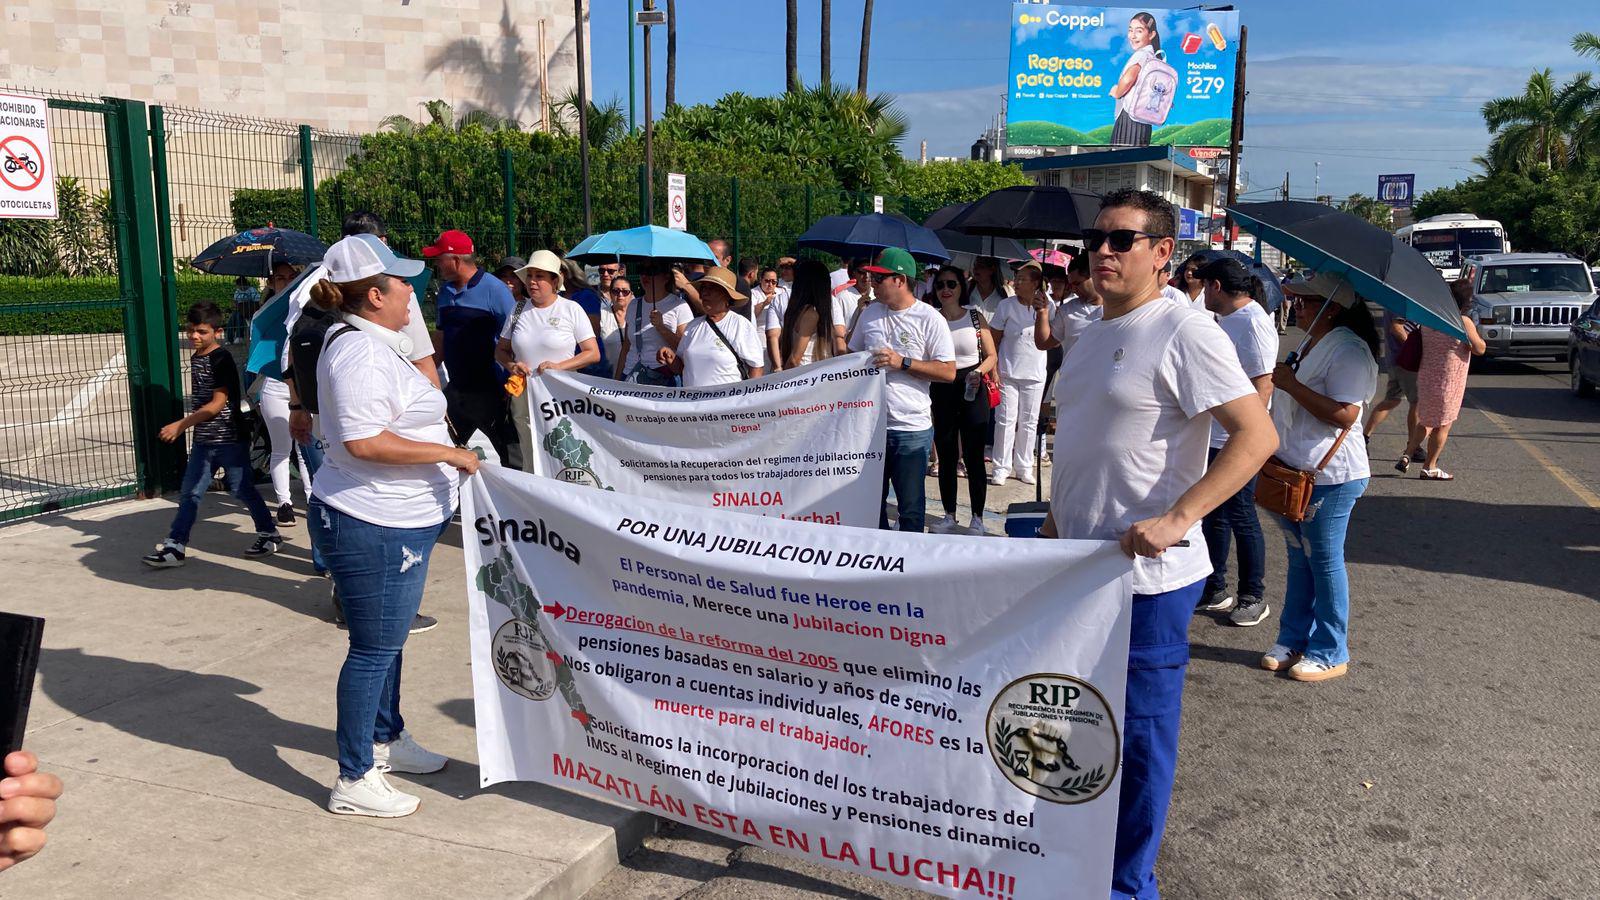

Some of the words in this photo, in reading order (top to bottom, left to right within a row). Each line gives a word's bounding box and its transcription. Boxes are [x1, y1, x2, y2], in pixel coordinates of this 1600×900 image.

[1046, 11, 1103, 30] Coppel
[1029, 54, 1093, 72] Regreso
[1017, 73, 1054, 89] para
[1059, 72, 1101, 87] todos
[1187, 77, 1224, 93] $279
[0, 201, 51, 209] OTOCICLETAS
[589, 387, 663, 399] Recuperemos
[666, 389, 676, 399] el
[679, 390, 726, 400] Regimen
[729, 387, 741, 397] de
[744, 379, 808, 395] Jubilaciones
[811, 376, 818, 386] y
[821, 368, 880, 382] Pensiones
[540, 396, 616, 423] Sinaloa
[636, 414, 665, 424] trabajo
[668, 414, 678, 422] de
[681, 414, 697, 422] una
[699, 411, 718, 422] vida
[722, 411, 756, 422] merece
[759, 410, 776, 419] una
[778, 404, 827, 418] Jubilación
[830, 403, 835, 412] y
[837, 400, 874, 409] Pension
[731, 423, 761, 433] Digna!
[620, 459, 668, 469] Solicitamos
[671, 459, 678, 468] la
[681, 458, 743, 471] Recuperacion
[747, 457, 761, 466] del
[763, 454, 801, 466] regimen
[803, 453, 813, 463] de
[815, 452, 875, 464] jubilaciones
[877, 452, 883, 461] y
[565, 471, 584, 479] RJP
[643, 472, 687, 483] pensiones
[689, 472, 709, 482] para
[712, 471, 739, 481] todos
[741, 470, 755, 479] los
[757, 467, 813, 480] trabajadores
[815, 467, 830, 476] del
[833, 466, 860, 476] IMSS.
[712, 491, 783, 507] SINALOA
[616, 517, 660, 541] POR
[662, 527, 707, 549] UNA
[707, 532, 832, 567] JUBILACION
[835, 551, 905, 573] DIGNA
[619, 557, 633, 571] El
[636, 561, 702, 588] Personal
[705, 575, 725, 592] de
[729, 580, 776, 600] Salud
[780, 586, 810, 606] fue
[815, 592, 872, 613] Heroe
[877, 602, 901, 617] en
[906, 602, 924, 619] la
[611, 578, 690, 609] pandemia,
[692, 594, 752, 619] Merece
[756, 609, 789, 626] una
[792, 612, 884, 639] Jubilacion
[889, 626, 947, 648] Digna
[514, 623, 535, 640] RJP
[564, 605, 656, 633] Derogacion
[658, 622, 677, 638] de
[680, 626, 694, 641] la
[698, 629, 763, 657] reforma
[768, 640, 793, 661] del
[798, 651, 838, 670] 2005
[843, 661, 877, 680] que
[882, 665, 952, 691] elimino
[957, 675, 982, 698] las
[578, 633, 661, 659] pensiones
[663, 644, 729, 671] basadas
[732, 662, 753, 677] en
[757, 667, 814, 689] salario
[818, 679, 829, 694] y
[833, 679, 874, 702] años
[879, 688, 900, 707] de
[905, 696, 964, 725] servio.
[564, 655, 591, 673] Nos
[594, 660, 672, 688] obligaron
[675, 677, 685, 688] a
[689, 678, 754, 702] cuentas
[758, 690, 864, 730] individuales,
[867, 714, 934, 746] AFORES
[939, 734, 960, 752] es
[966, 736, 984, 755] la
[1029, 683, 1080, 707] RJP
[1008, 703, 1055, 713] RECUPEREMOS
[1066, 708, 1094, 718] RÉGIMEN
[1013, 711, 1058, 720] JUBILACIONES
[1065, 716, 1099, 726] PENSIONES
[654, 697, 715, 720] muerte
[718, 710, 756, 730] para
[759, 716, 775, 733] el
[778, 720, 872, 758] trabajador.
[591, 716, 673, 750] Solicitamos
[677, 736, 692, 754] la
[697, 740, 809, 783] incorporacion
[813, 769, 838, 792] del
[842, 776, 867, 799] los
[871, 784, 997, 823] trabajadores
[1002, 809, 1035, 829] del
[586, 734, 618, 757] IMSS
[620, 748, 633, 763] al
[636, 751, 702, 782] Regimen
[705, 770, 726, 787] de
[727, 773, 828, 815] Jubilaciones
[831, 805, 842, 821] y
[847, 807, 942, 839] Pensiones
[947, 826, 1047, 859] dinamico.
[552, 753, 688, 817] MAZATLÁN
[692, 802, 763, 841] ESTA
[768, 823, 811, 853] EN
[819, 836, 860, 867] LA
[869, 847, 1016, 900] LUCHA!!!
